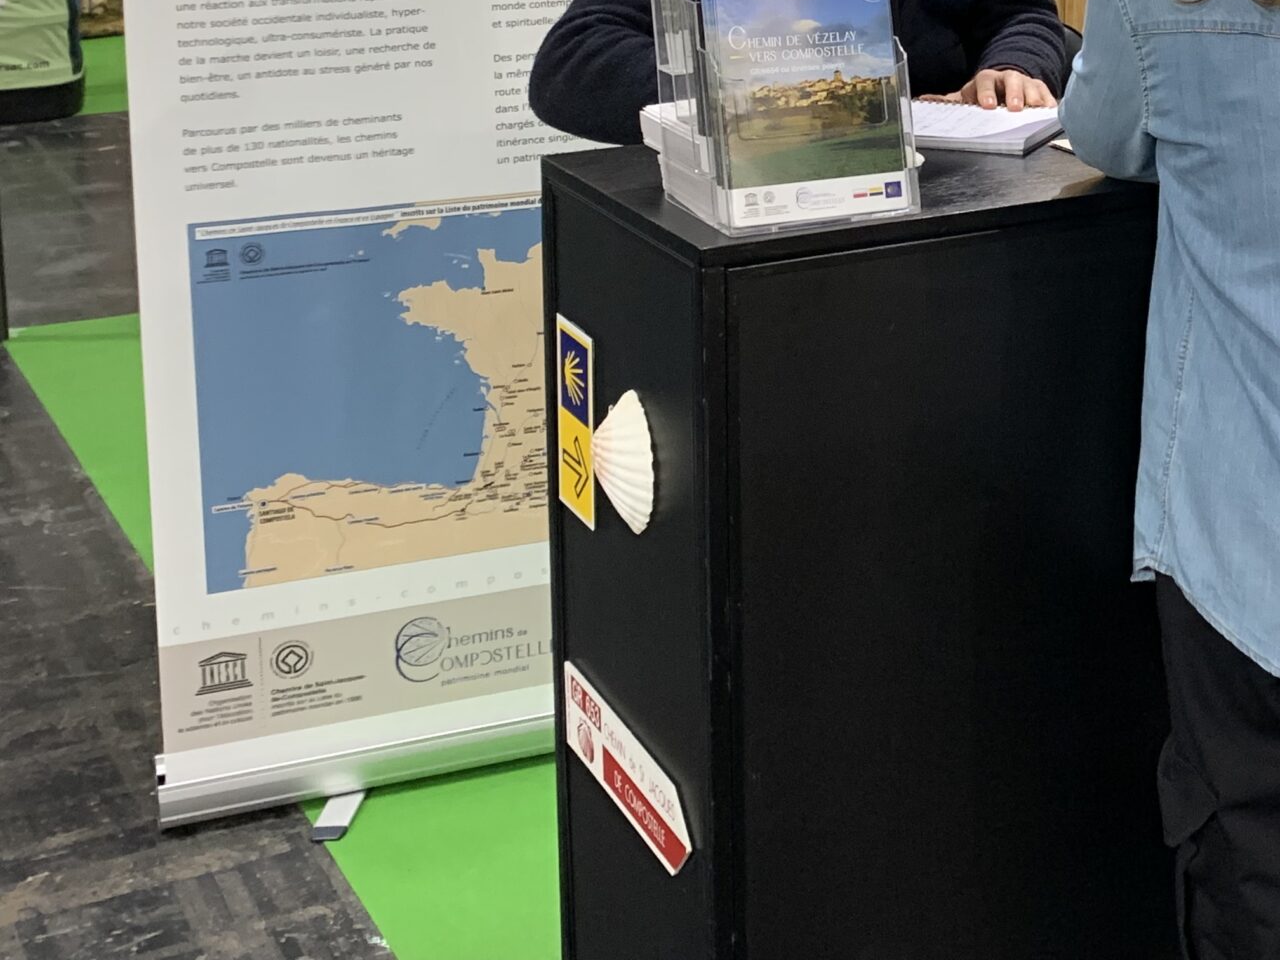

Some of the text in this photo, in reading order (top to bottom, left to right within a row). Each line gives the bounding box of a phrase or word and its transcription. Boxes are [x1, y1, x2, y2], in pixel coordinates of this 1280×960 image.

[491, 1, 526, 11] monde
[391, 7, 426, 18] hyper-
[492, 20, 502, 28] et
[370, 28, 382, 36] La
[385, 24, 428, 35] pratique
[786, 34, 802, 47] DE
[806, 29, 857, 45] VÉZELAY
[345, 45, 365, 55] une
[369, 42, 420, 53] recherche
[423, 40, 436, 50] de
[748, 43, 865, 63] VERS COMPOSTELLE
[493, 53, 512, 63] Des
[354, 61, 391, 74] généré
[394, 60, 411, 71] par
[414, 58, 433, 67] nos
[494, 71, 503, 79] la
[494, 87, 521, 96] route
[495, 103, 519, 113] dans
[496, 119, 534, 131] chargés
[372, 145, 415, 158] héritage
[497, 155, 509, 164] un
